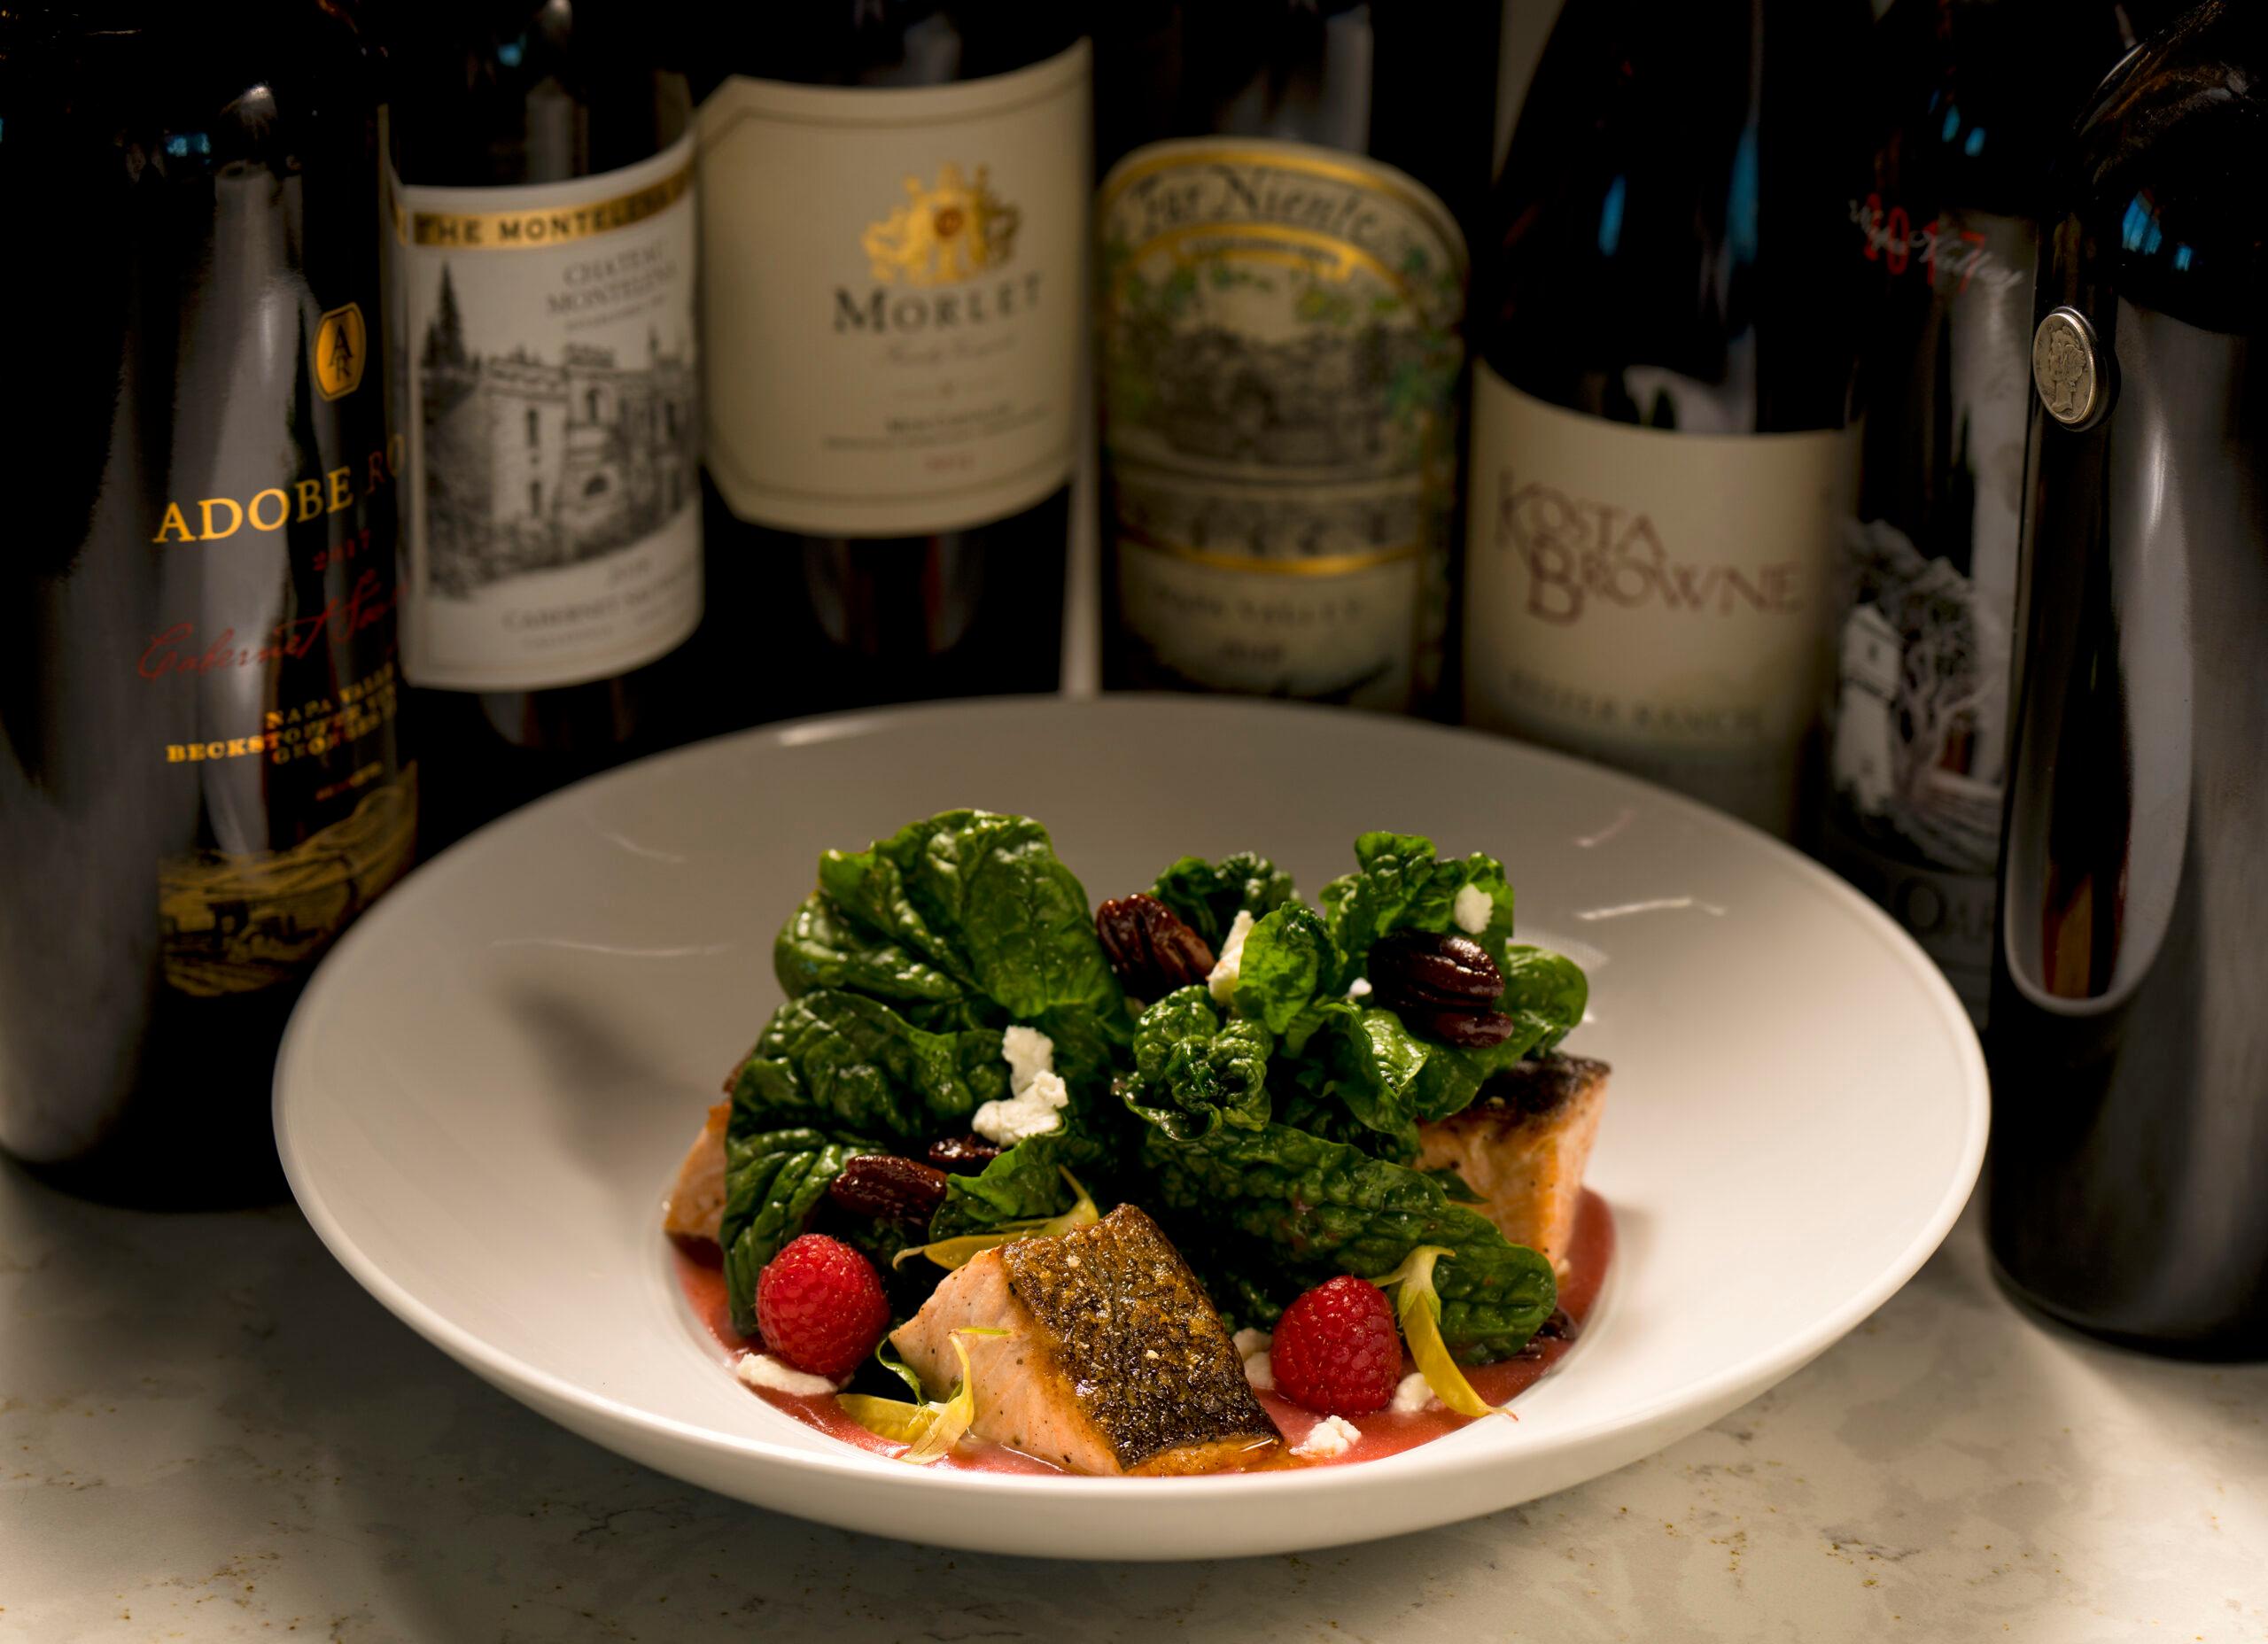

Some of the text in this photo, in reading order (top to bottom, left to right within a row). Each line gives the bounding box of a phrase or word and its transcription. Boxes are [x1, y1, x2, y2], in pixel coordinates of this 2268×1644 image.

[414, 213, 485, 244] THE
[152, 464, 354, 543] ADOBE
[1495, 468, 1667, 574] KOSTA
[1527, 531, 1804, 626] BROWNE
